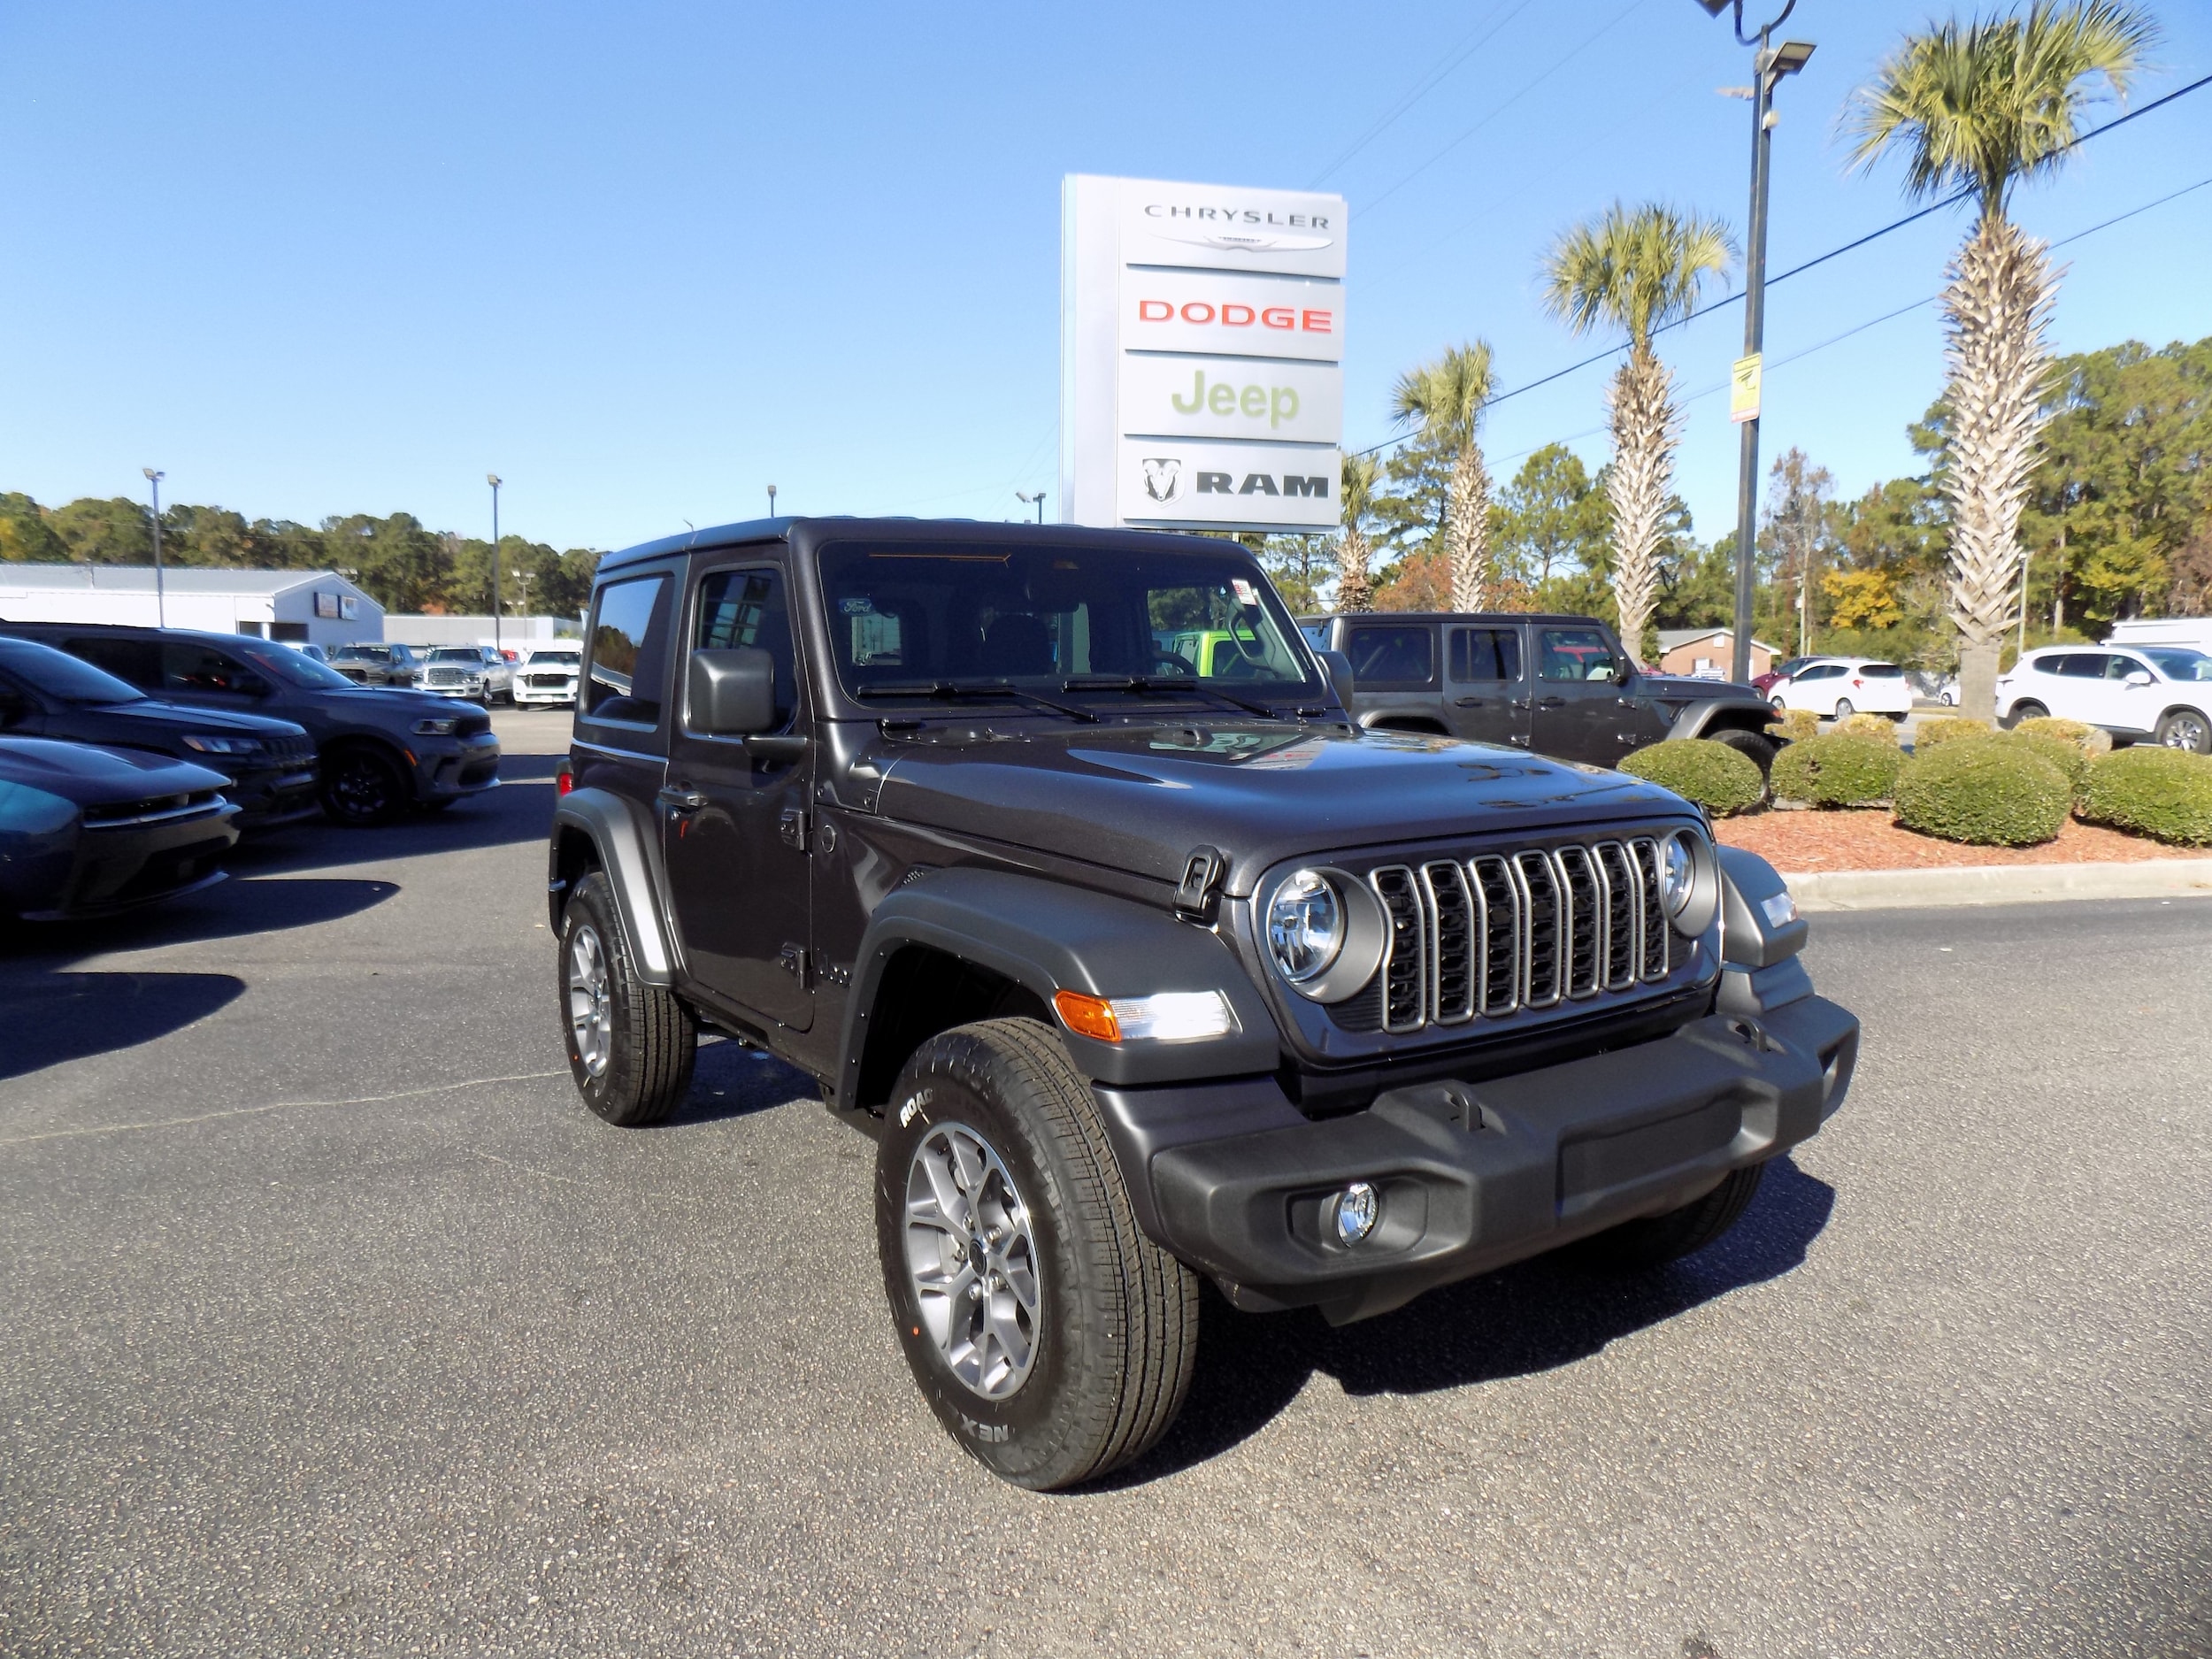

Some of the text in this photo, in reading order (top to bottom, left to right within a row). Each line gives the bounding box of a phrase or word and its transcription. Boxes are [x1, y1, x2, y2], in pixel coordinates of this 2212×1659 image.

[1144, 204, 1329, 230] CHRYSLER
[1139, 300, 1333, 334] DODGE
[1171, 370, 1300, 429] Jeep
[1196, 471, 1329, 498] RAM
[843, 601, 872, 612] Ford
